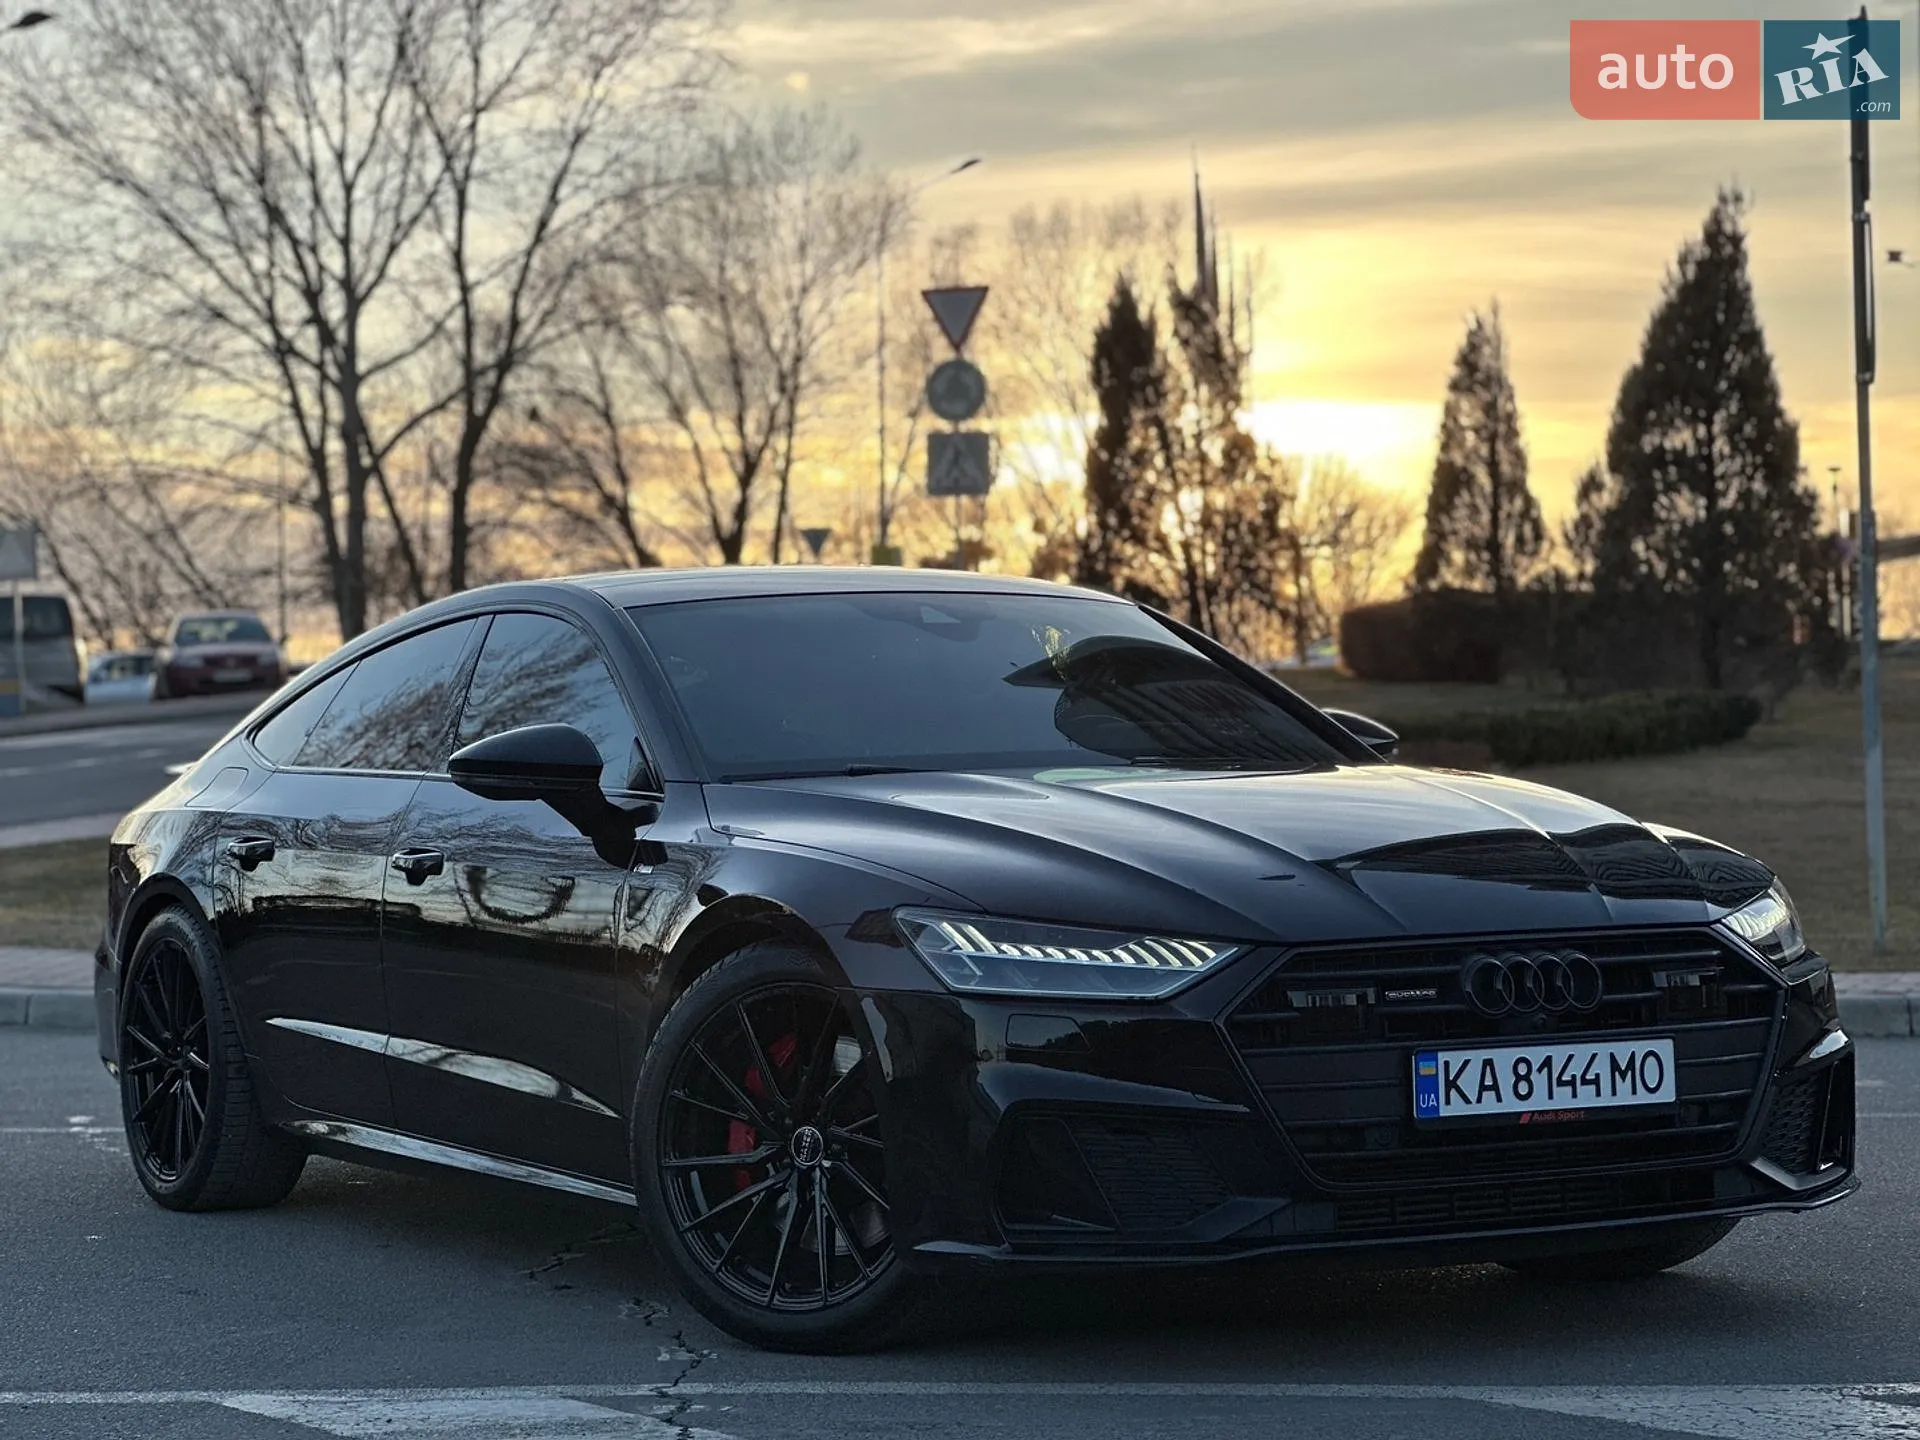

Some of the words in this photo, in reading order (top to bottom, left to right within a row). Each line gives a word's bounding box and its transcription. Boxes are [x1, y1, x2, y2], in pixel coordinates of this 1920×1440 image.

[1443, 1058, 1503, 1106] KA
[1511, 1053, 1601, 1101] 8144
[1609, 1049, 1665, 1097] MO
[1419, 1094, 1438, 1108] UA
